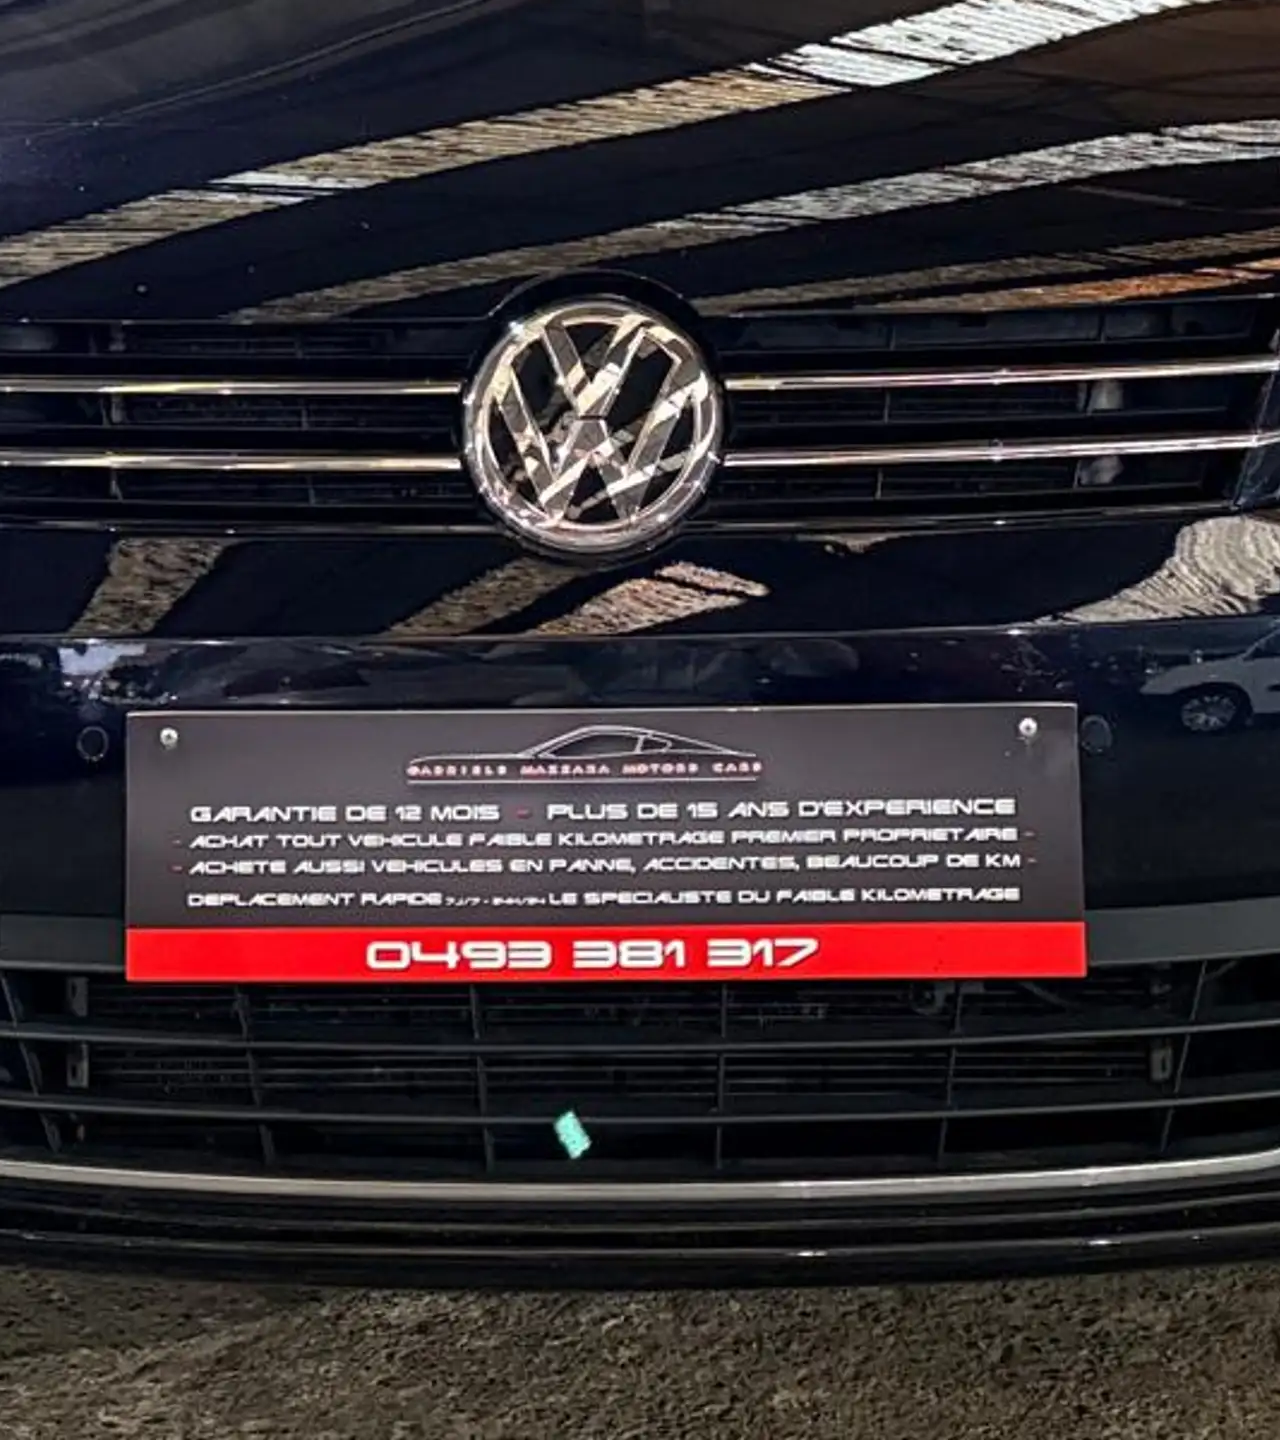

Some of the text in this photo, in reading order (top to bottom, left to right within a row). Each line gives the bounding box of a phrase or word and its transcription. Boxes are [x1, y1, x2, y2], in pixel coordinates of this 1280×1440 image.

[190, 805, 338, 823] GARANTIE
[344, 804, 387, 822] DE
[394, 804, 422, 822] 12
[429, 803, 501, 822] MOIS
[546, 803, 629, 821] PLUS
[636, 802, 679, 820] DE
[685, 801, 719, 819] 15
[726, 800, 790, 818] ANS
[797, 798, 1016, 817] D'EXPERIENCE
[189, 827, 1018, 849] ACHAT TOUT VEHICULE FAIBLE KILOMETRAGE PREMIER PROPRIETAIRE
[189, 859, 287, 875] ACHETE
[293, 859, 366, 874] AUSSI
[371, 858, 504, 873] VEHICULES
[508, 858, 544, 873] EN
[805, 853, 939, 869] BEAUCOUP
[945, 853, 980, 868] DE
[985, 853, 1021, 868] KM
[187, 892, 356, 907] DEPLACEMENT
[360, 892, 443, 906] RAPIDE
[548, 892, 578, 906] LE
[583, 890, 732, 905] SPECIALISTE
[737, 889, 771, 904] DU
[776, 888, 856, 903] FAIBLE
[861, 887, 1020, 902] KILOMETRAGE
[366, 937, 819, 969] 0493 381 317
